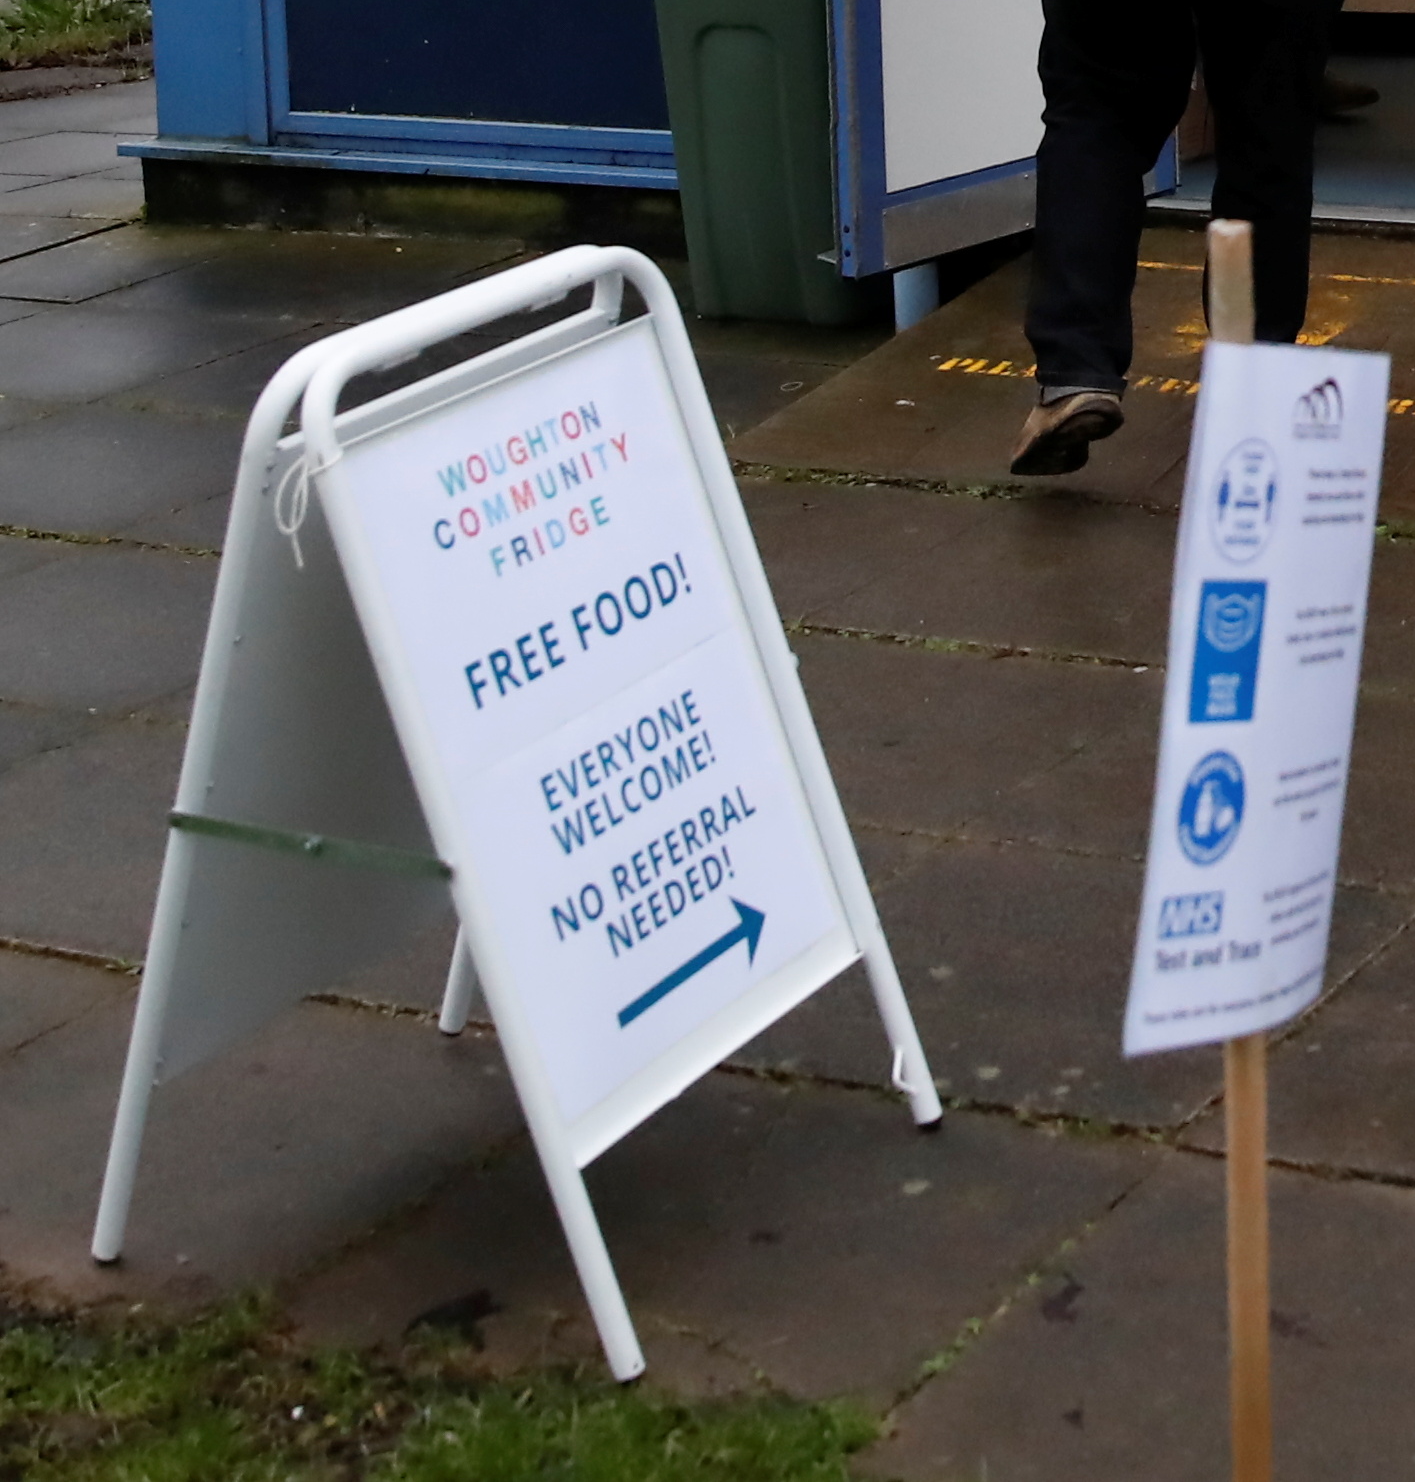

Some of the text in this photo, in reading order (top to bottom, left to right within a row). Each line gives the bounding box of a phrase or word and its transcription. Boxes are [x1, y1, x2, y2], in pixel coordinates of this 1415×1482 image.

[434, 433, 629, 550] COMMUNITY
[437, 401, 602, 498] WOUGHTON
[489, 496, 610, 577] FRIDGE
[464, 552, 691, 710] FREE FOOD!
[540, 689, 701, 812] EVERYONE
[551, 730, 716, 855] WELCOME!
[551, 785, 756, 941] NO REFERRAL
[606, 845, 735, 958] NEEDED!
[1159, 893, 1222, 938] NHS
[1192, 945, 1223, 967] and
